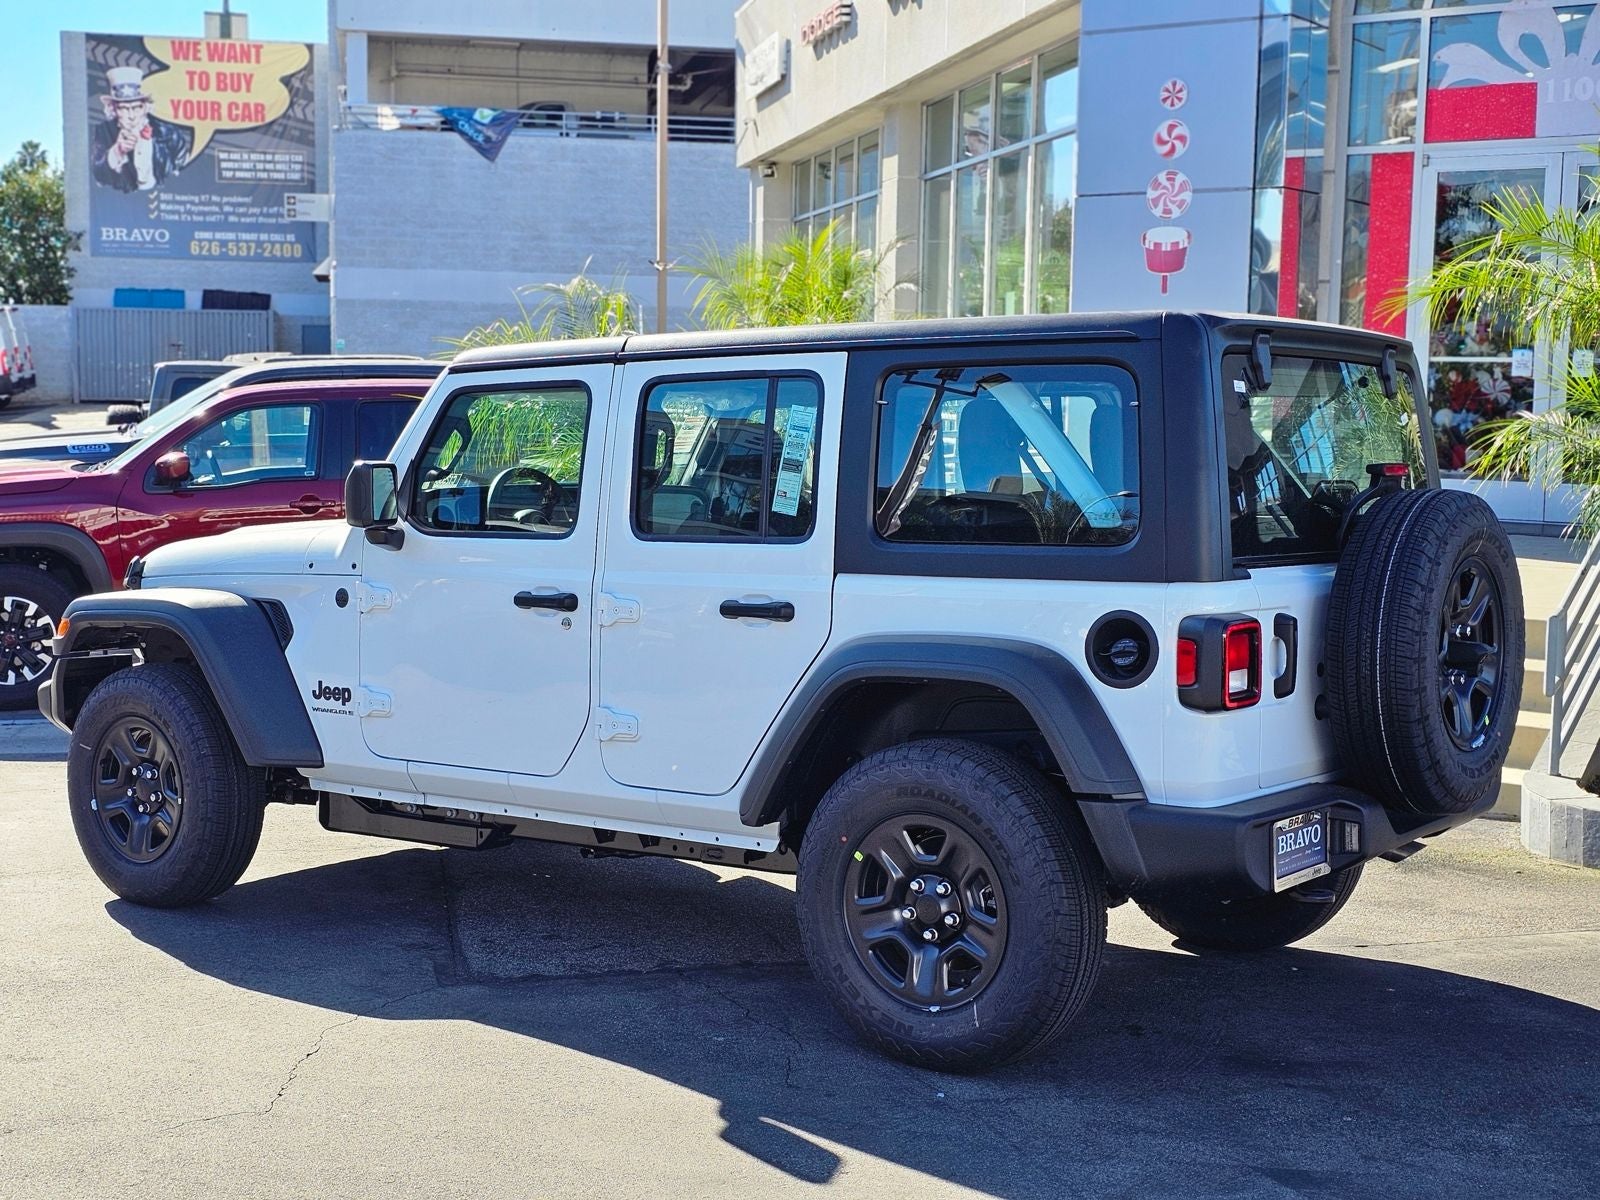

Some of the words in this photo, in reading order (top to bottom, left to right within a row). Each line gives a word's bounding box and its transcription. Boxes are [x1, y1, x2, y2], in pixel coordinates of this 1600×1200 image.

[801, 2, 852, 48] DODGE
[170, 40, 202, 61] WE
[206, 41, 264, 64] WANT
[185, 70, 210, 92] TO
[216, 71, 254, 93] BUY
[1545, 77, 1600, 103] 110
[170, 99, 222, 121] YOUR
[227, 101, 266, 123] CAR
[100, 227, 170, 242] BRAVO
[190, 240, 302, 258] 626-537-2400
[312, 680, 352, 706] Jeep
[1288, 811, 1315, 828] BRAVO
[1277, 824, 1321, 855] BRAVO
